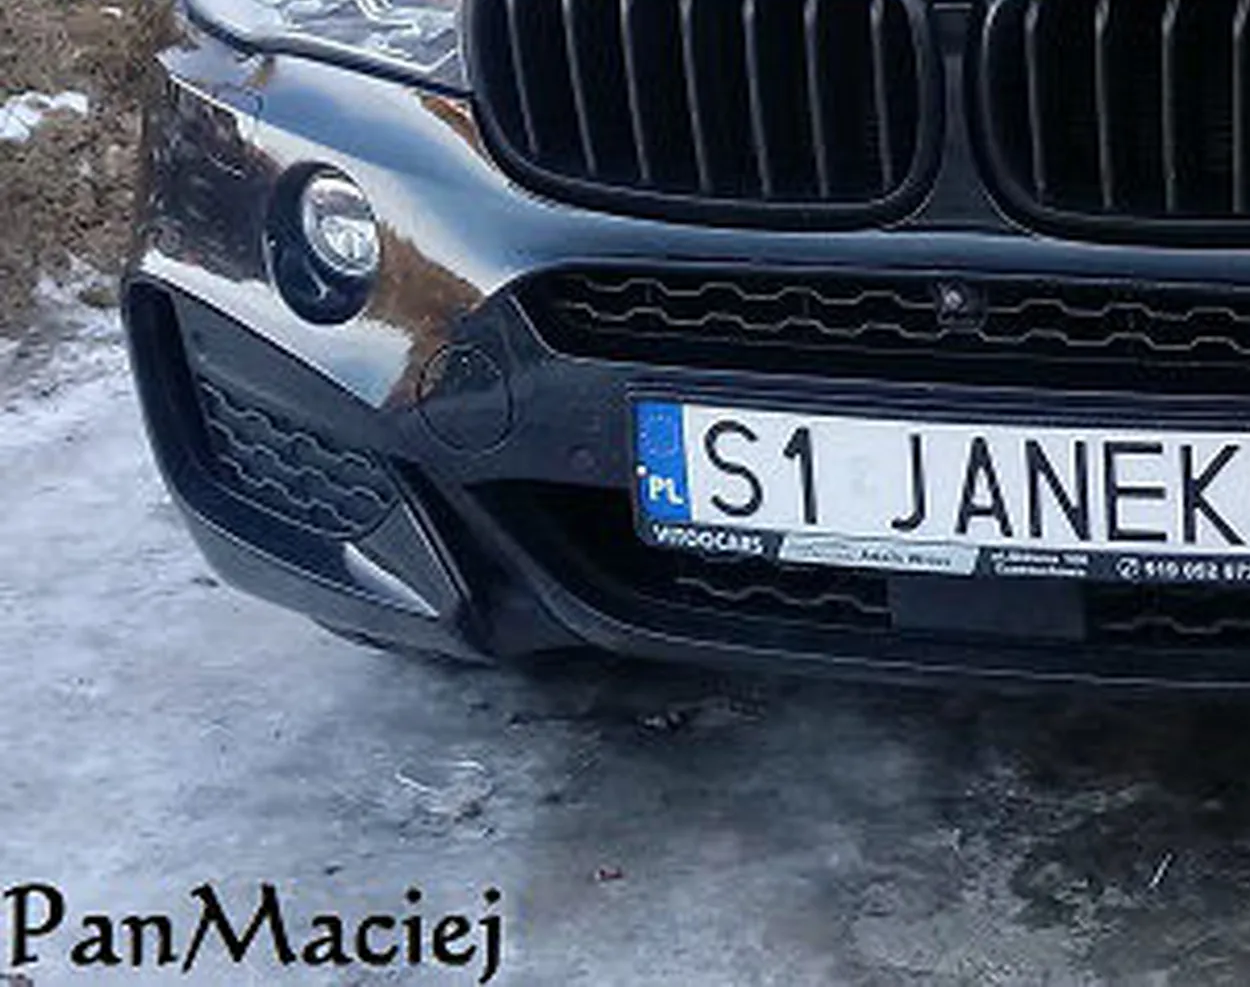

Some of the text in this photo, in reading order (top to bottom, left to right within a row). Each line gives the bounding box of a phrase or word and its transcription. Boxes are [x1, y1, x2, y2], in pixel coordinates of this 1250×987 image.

[649, 477, 684, 505] PL
[702, 419, 1246, 546] S1 JANEK
